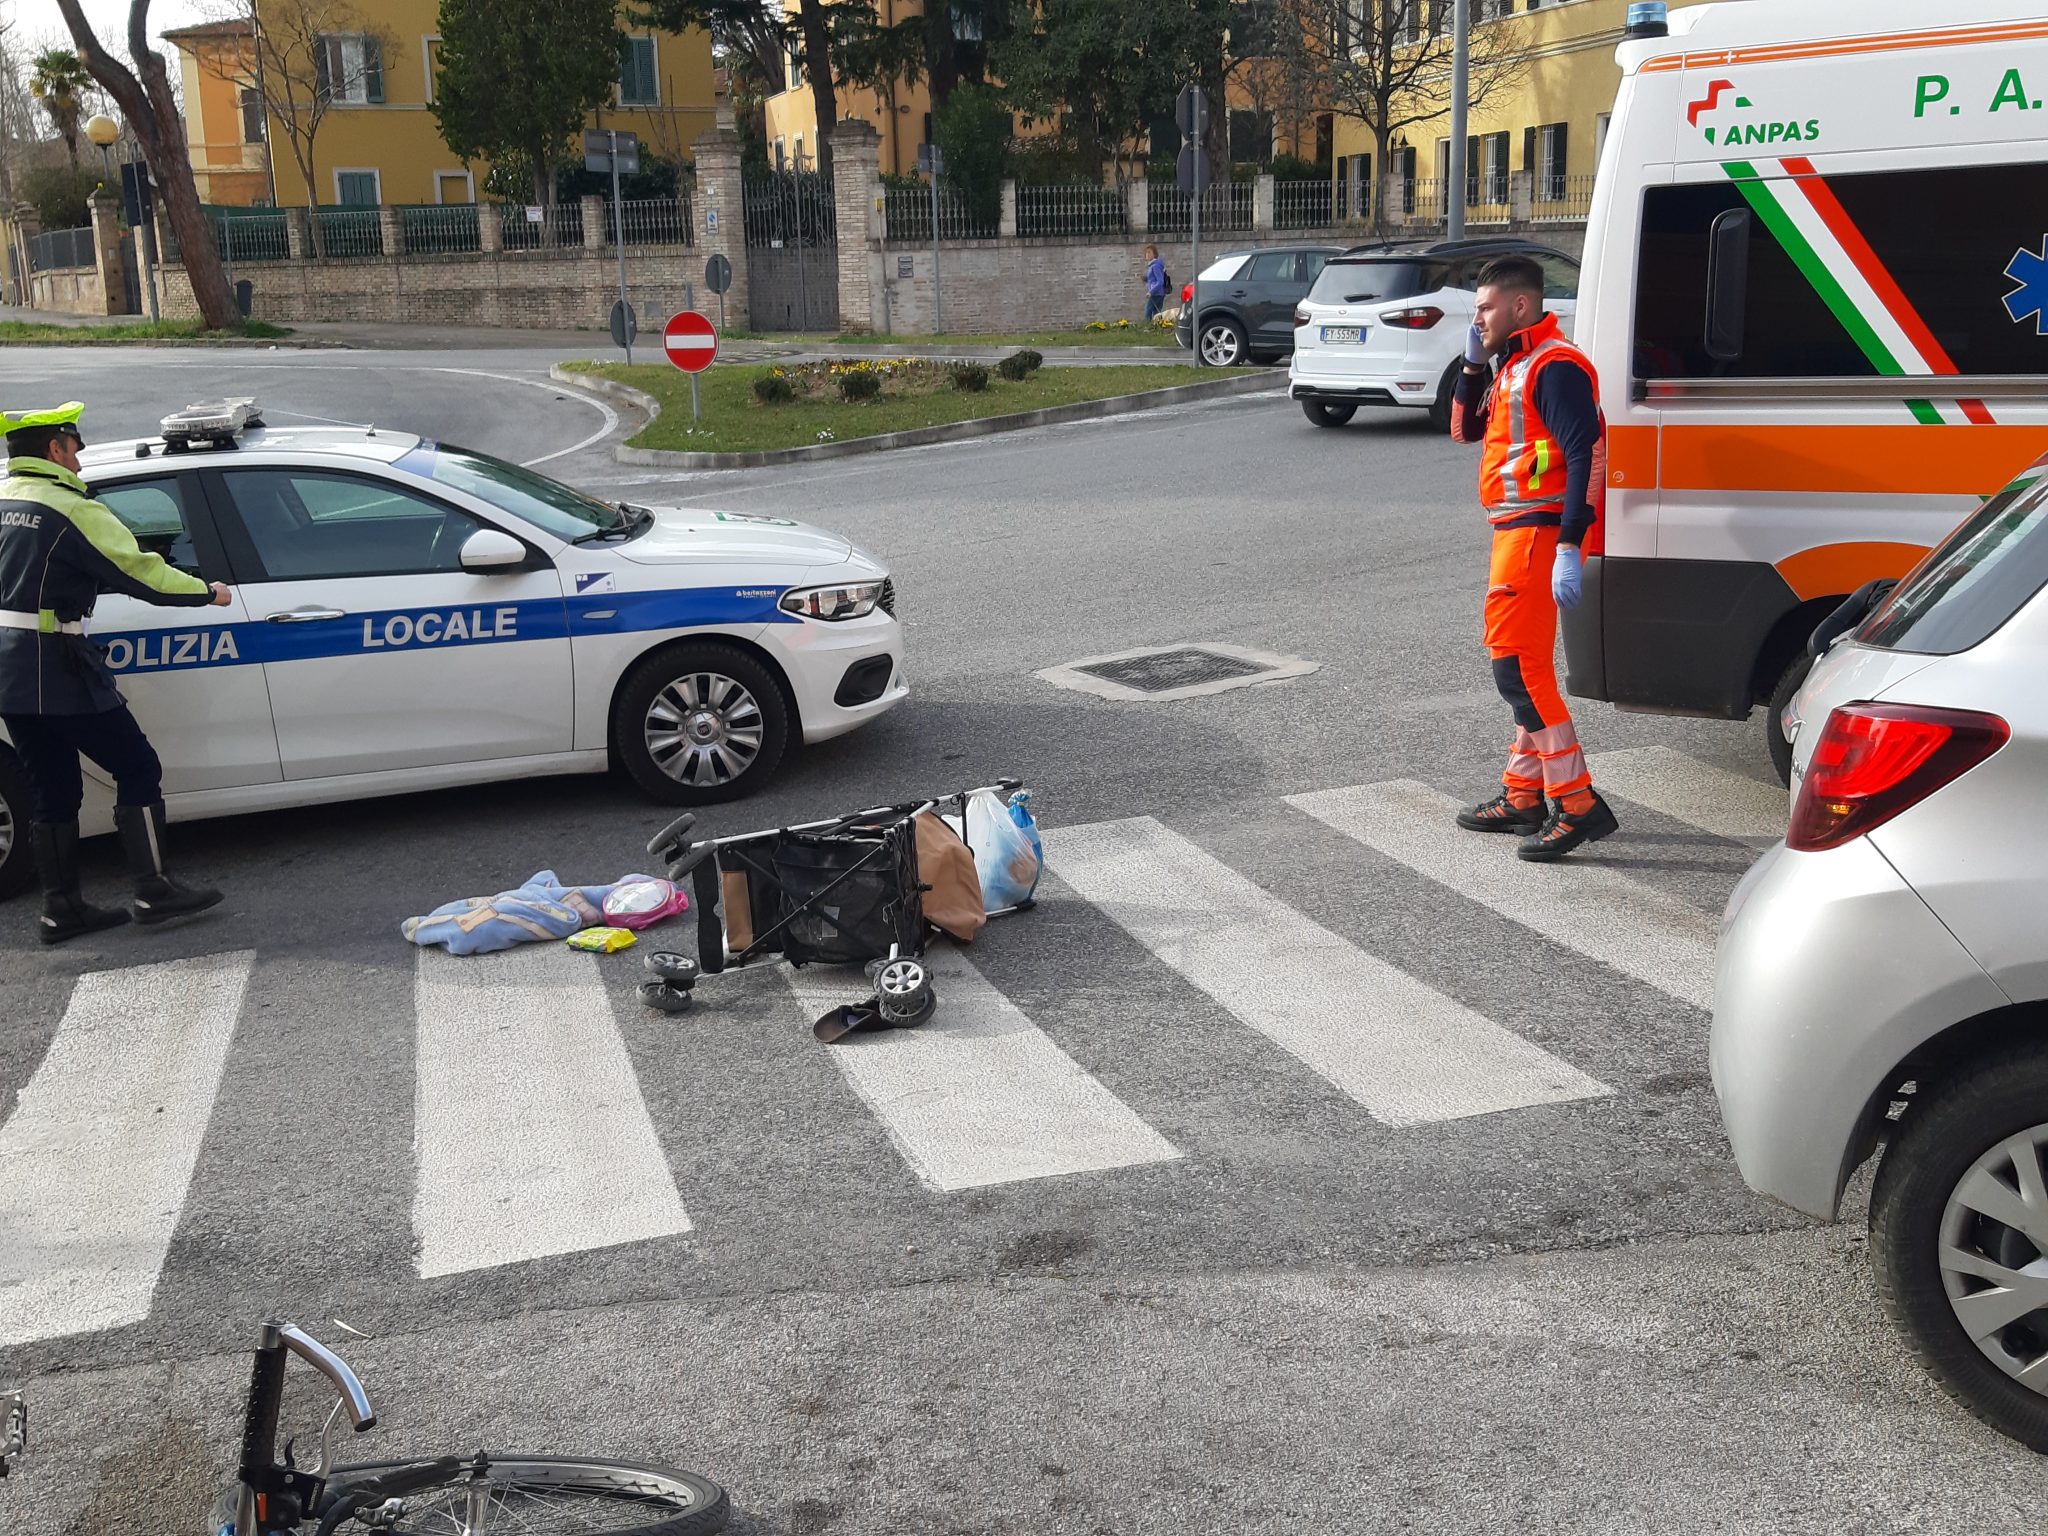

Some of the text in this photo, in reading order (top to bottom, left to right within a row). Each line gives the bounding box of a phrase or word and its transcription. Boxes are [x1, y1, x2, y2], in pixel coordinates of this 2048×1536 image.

[1914, 68, 2042, 117] P. A.
[1723, 119, 1819, 146] ANPAS
[1, 511, 42, 529] LOCALE
[104, 607, 518, 669] OLIZIA LOCALE
